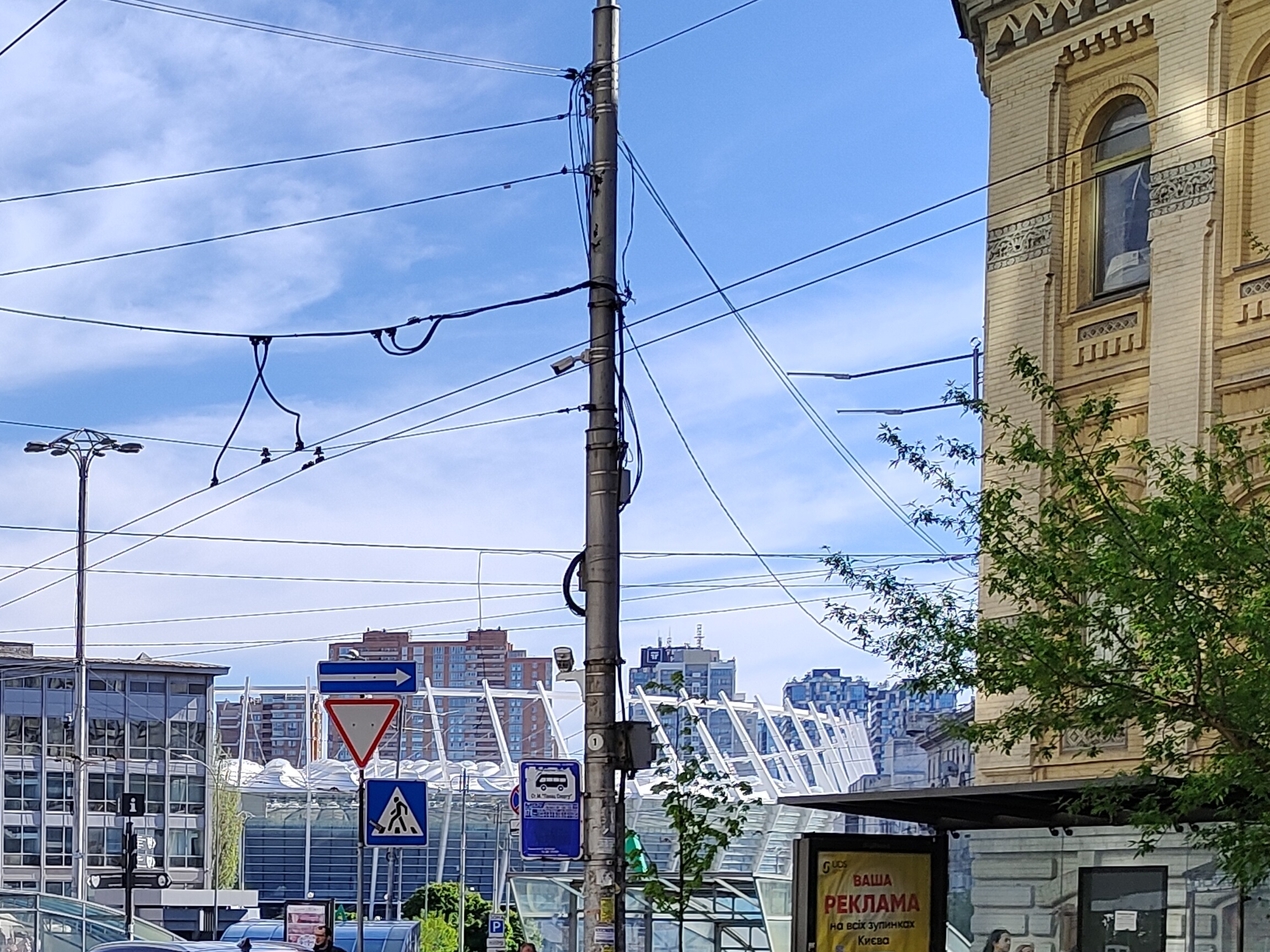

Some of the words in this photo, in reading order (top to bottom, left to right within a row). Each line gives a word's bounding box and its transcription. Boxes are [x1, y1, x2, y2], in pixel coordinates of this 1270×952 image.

[592, 737, 597, 747] 1
[853, 873, 892, 887] ВАША
[824, 893, 920, 914] РЕКЛАМА
[492, 921, 501, 932] P
[830, 922, 844, 930] на
[846, 920, 866, 930] всіх
[868, 920, 915, 932] зупинках
[857, 935, 890, 946] Києва
